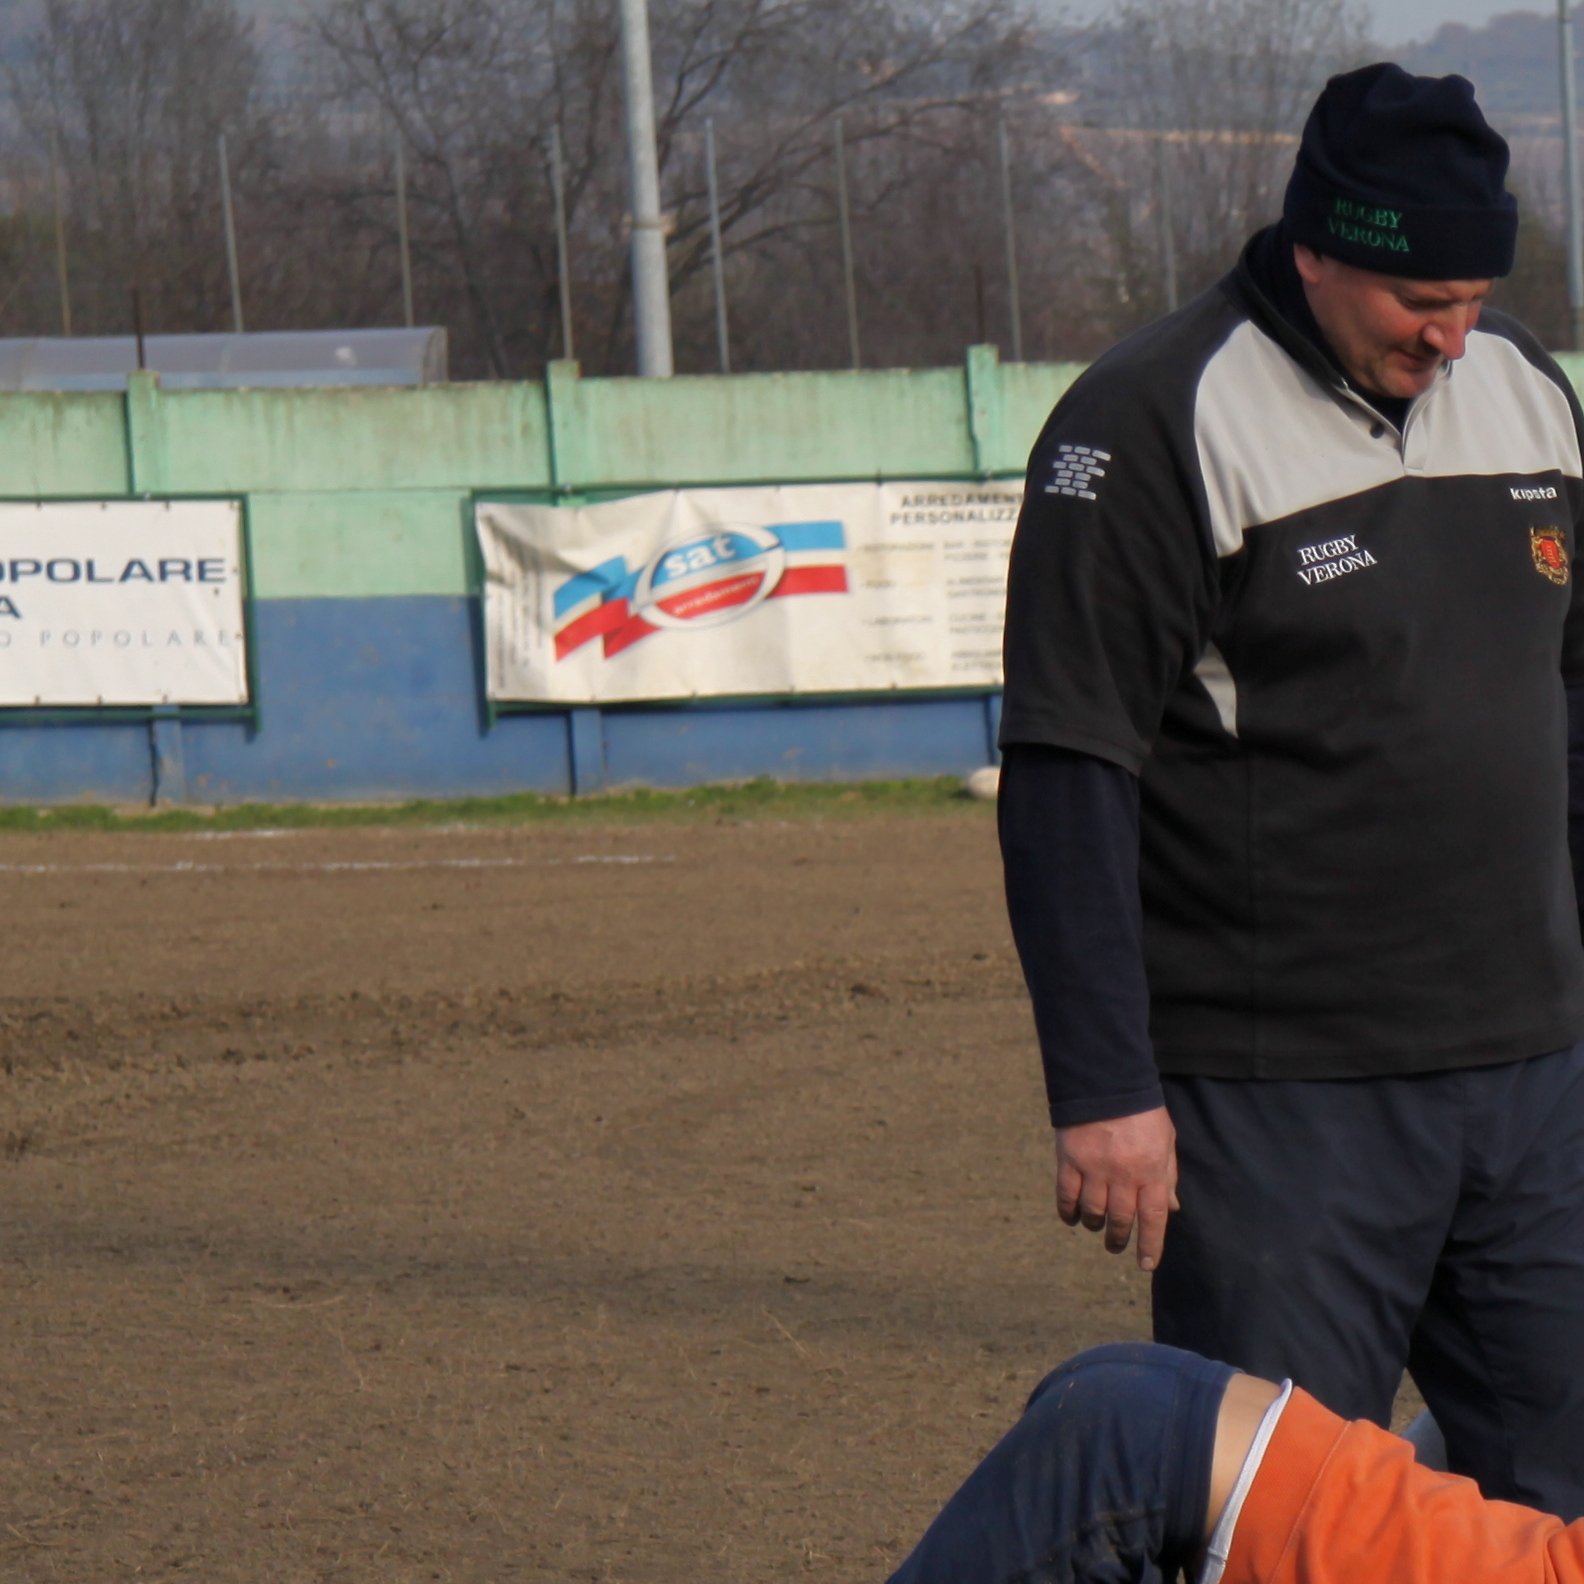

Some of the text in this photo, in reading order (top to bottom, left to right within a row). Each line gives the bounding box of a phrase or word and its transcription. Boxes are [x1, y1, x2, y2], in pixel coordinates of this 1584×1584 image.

[1335, 198, 1403, 230] RUGBY
[1328, 217, 1411, 253] VERONA
[1510, 486, 1558, 501] kipsta
[664, 537, 737, 578] sat
[1297, 534, 1359, 566] RUGBY
[1296, 549, 1378, 586] VERONA
